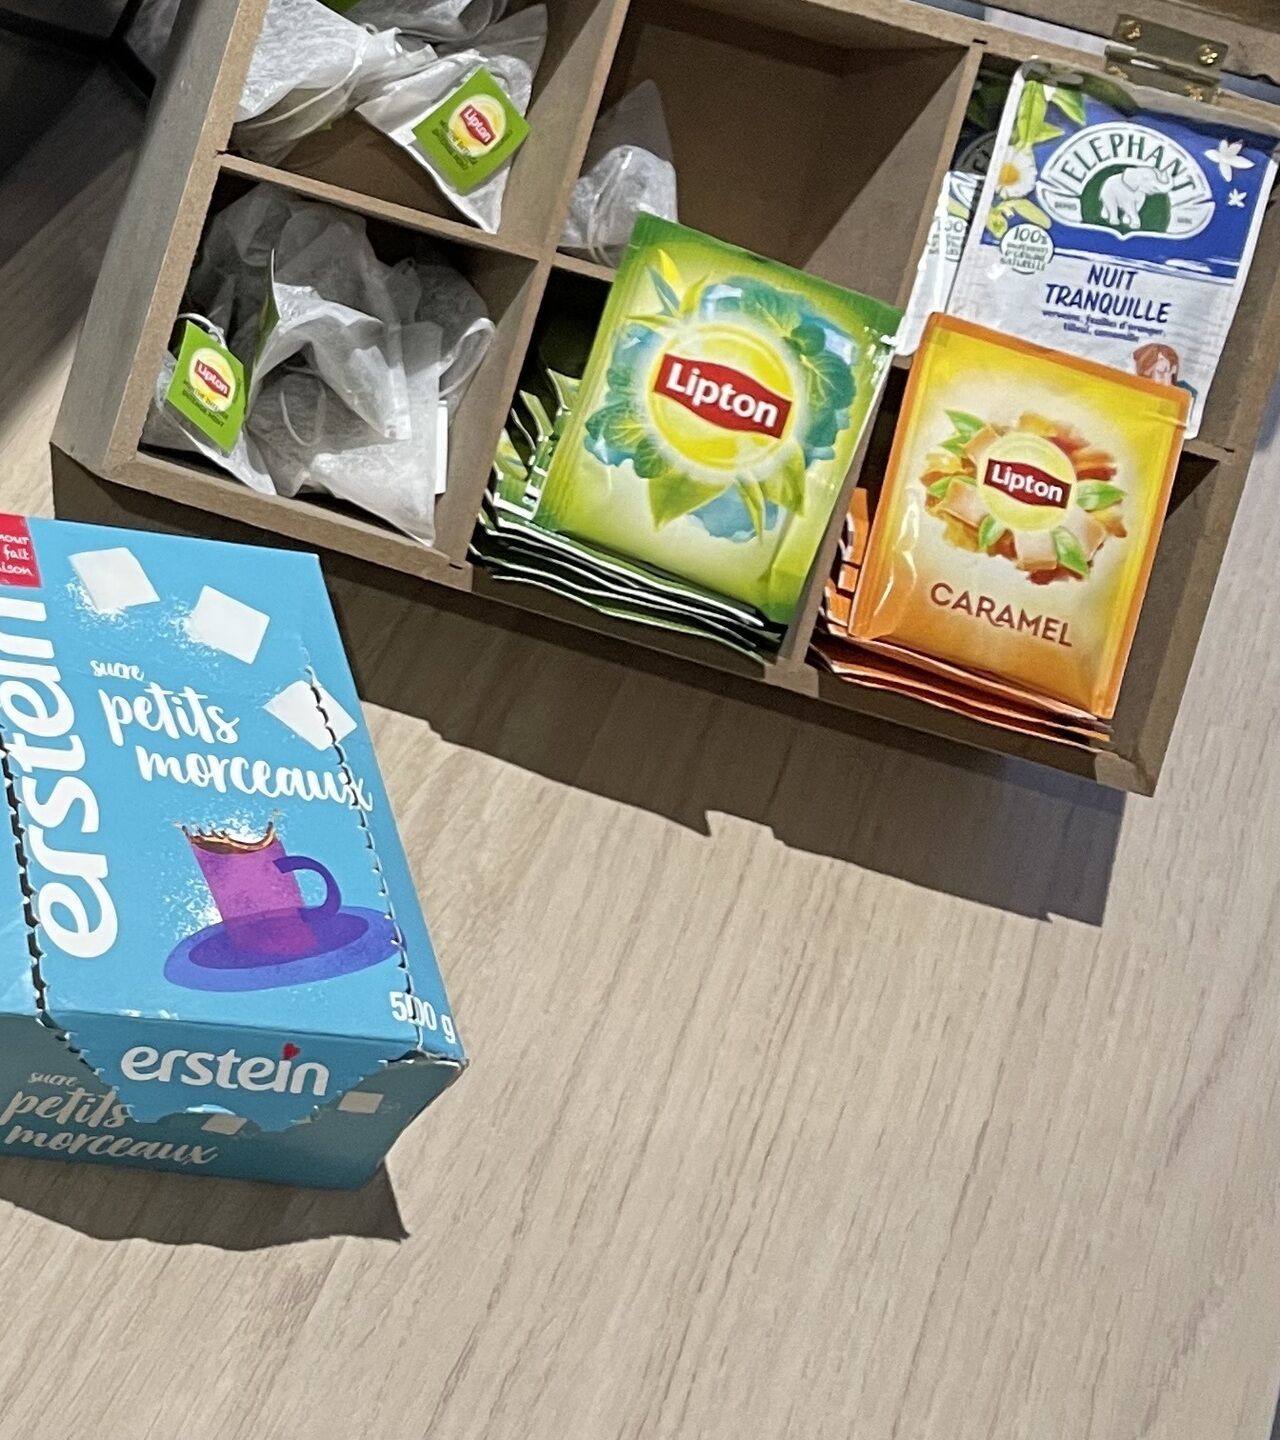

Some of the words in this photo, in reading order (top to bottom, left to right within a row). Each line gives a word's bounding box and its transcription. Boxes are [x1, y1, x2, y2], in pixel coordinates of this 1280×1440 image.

[462, 108, 492, 143] Lipton
[1088, 264, 1138, 290] NUIT
[1045, 283, 1172, 323] TRANQUILLE
[198, 363, 229, 395] Lipton
[666, 362, 779, 428] Lipton
[991, 465, 1064, 501] Lipton
[930, 582, 1072, 648] CARAMEL
[98, 681, 240, 747] petits
[135, 745, 372, 811] morceaux
[389, 992, 437, 1030] 500
[441, 1014, 456, 1044] g
[121, 1046, 329, 1096] erstein
[4, 1124, 218, 1166] morceaux
